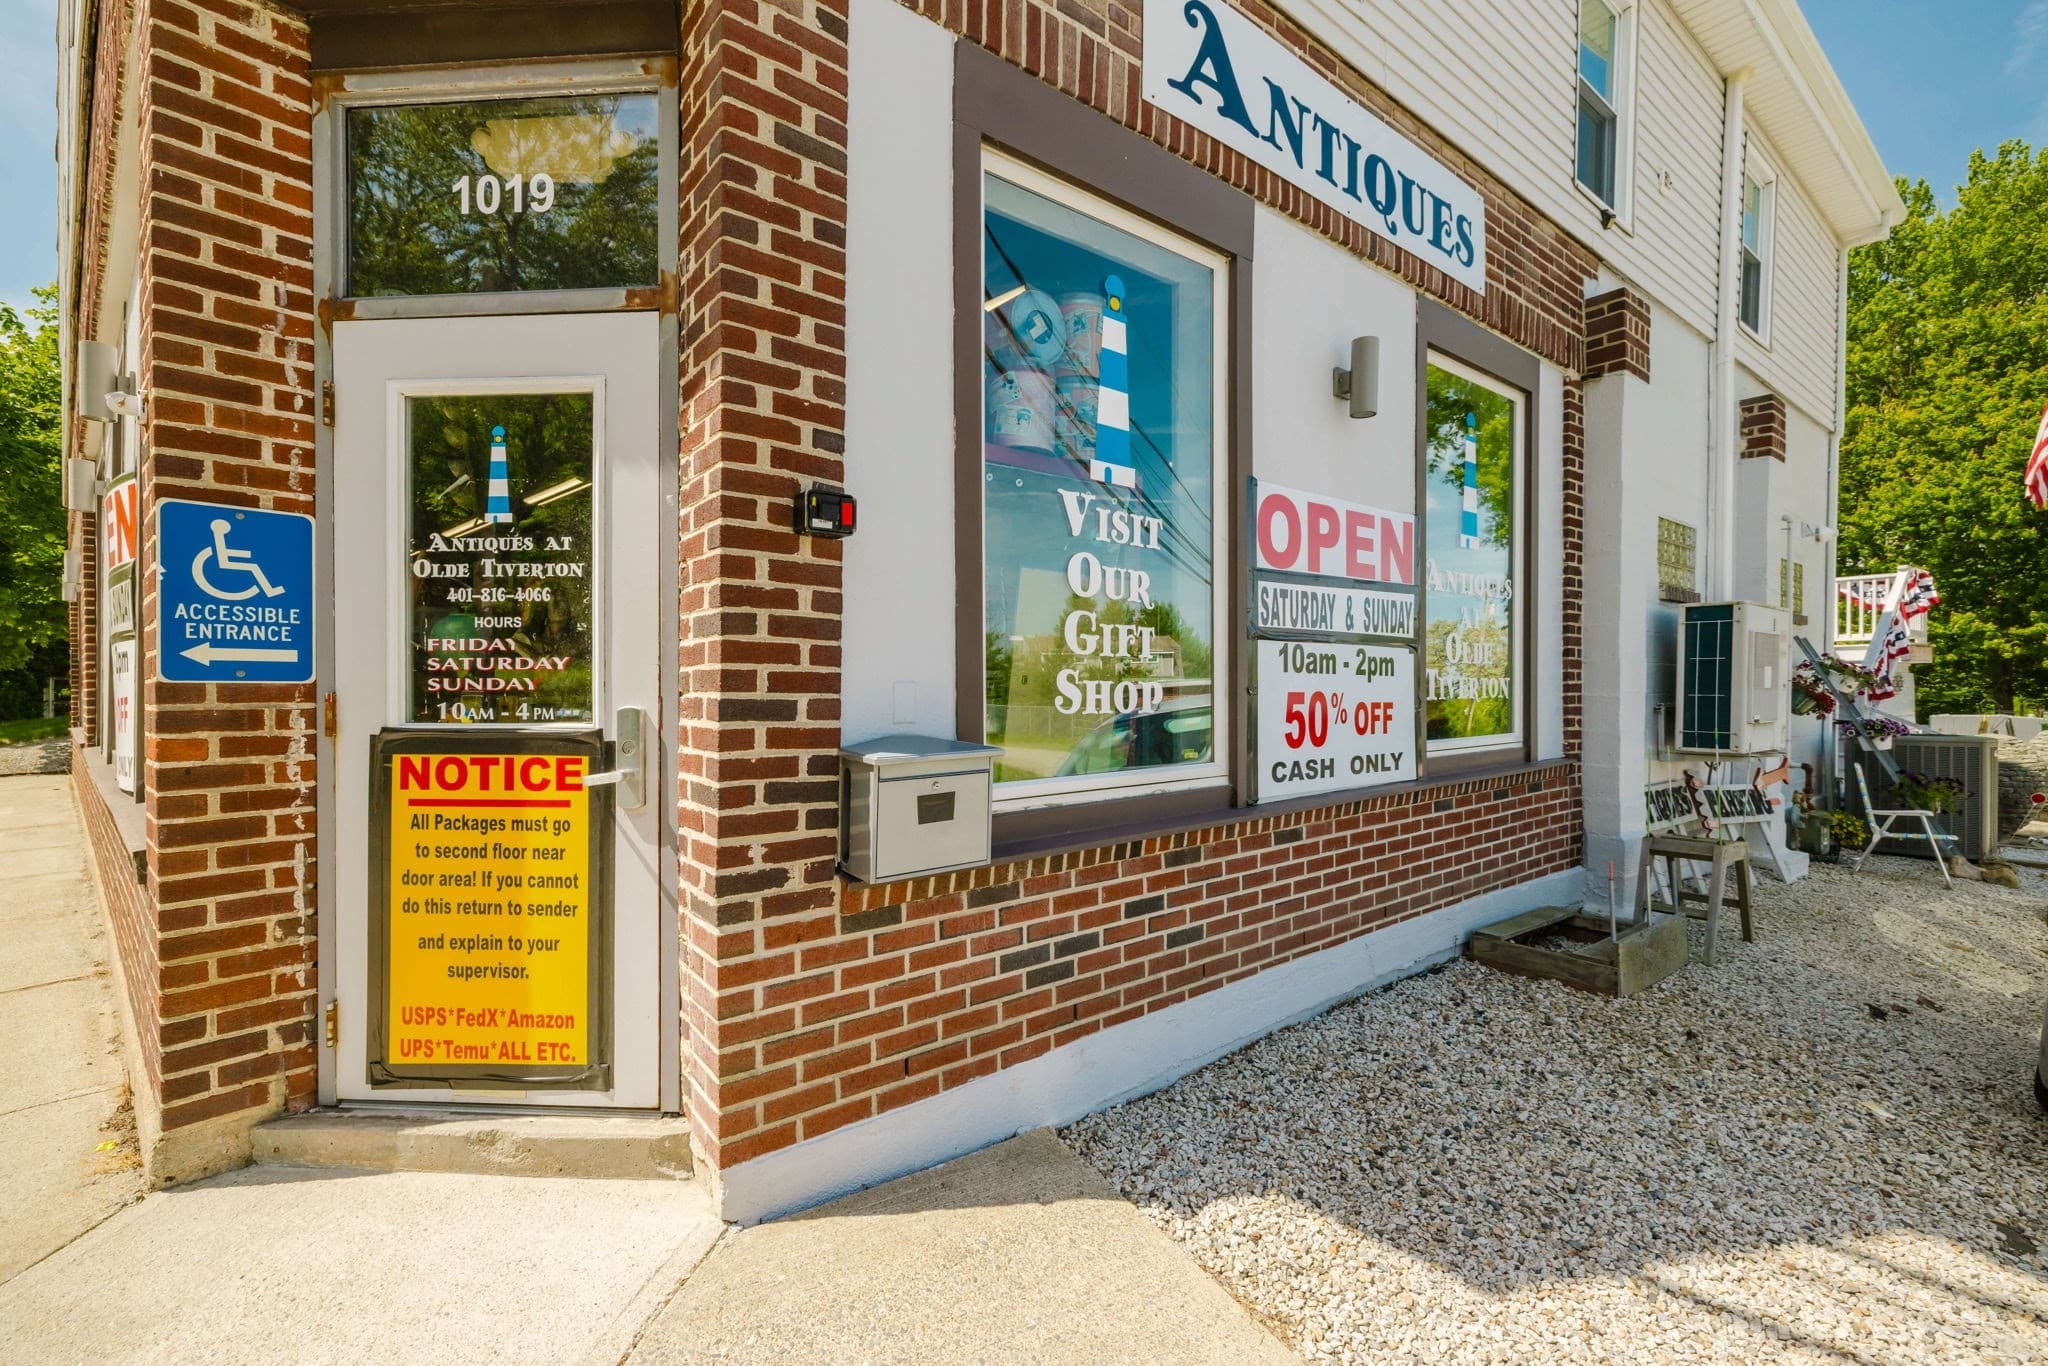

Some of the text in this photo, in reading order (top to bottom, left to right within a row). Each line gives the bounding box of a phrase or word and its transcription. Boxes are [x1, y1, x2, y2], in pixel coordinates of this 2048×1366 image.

[452, 173, 555, 215] 1019
[1257, 493, 1414, 585] OPEN
[447, 587, 551, 602] 401-816-4066
[174, 603, 301, 624] ACCESSIBLE
[1260, 586, 1413, 635] SATURDAY & SUNDAY
[185, 622, 292, 642] ENTRANCE
[474, 616, 522, 629] HOURS
[427, 638, 518, 652] FRIDAY
[427, 656, 572, 672] SATURDAY
[1278, 642, 1337, 675] 10am
[1355, 648, 1395, 683] 2pm
[427, 676, 542, 692] SUNDAY
[1354, 701, 1394, 736] OFF
[399, 756, 584, 792] NOTICE
[1271, 751, 1403, 783] CASH ONLY
[410, 813, 571, 837] All Packages must go
[415, 842, 566, 861] to second floor near
[401, 869, 579, 892] door area! If you cannot
[402, 897, 578, 917] do this return to sender
[418, 934, 560, 956] and explain to your
[447, 961, 530, 981] supervisor.
[537, 1042, 576, 1062] ETC.
